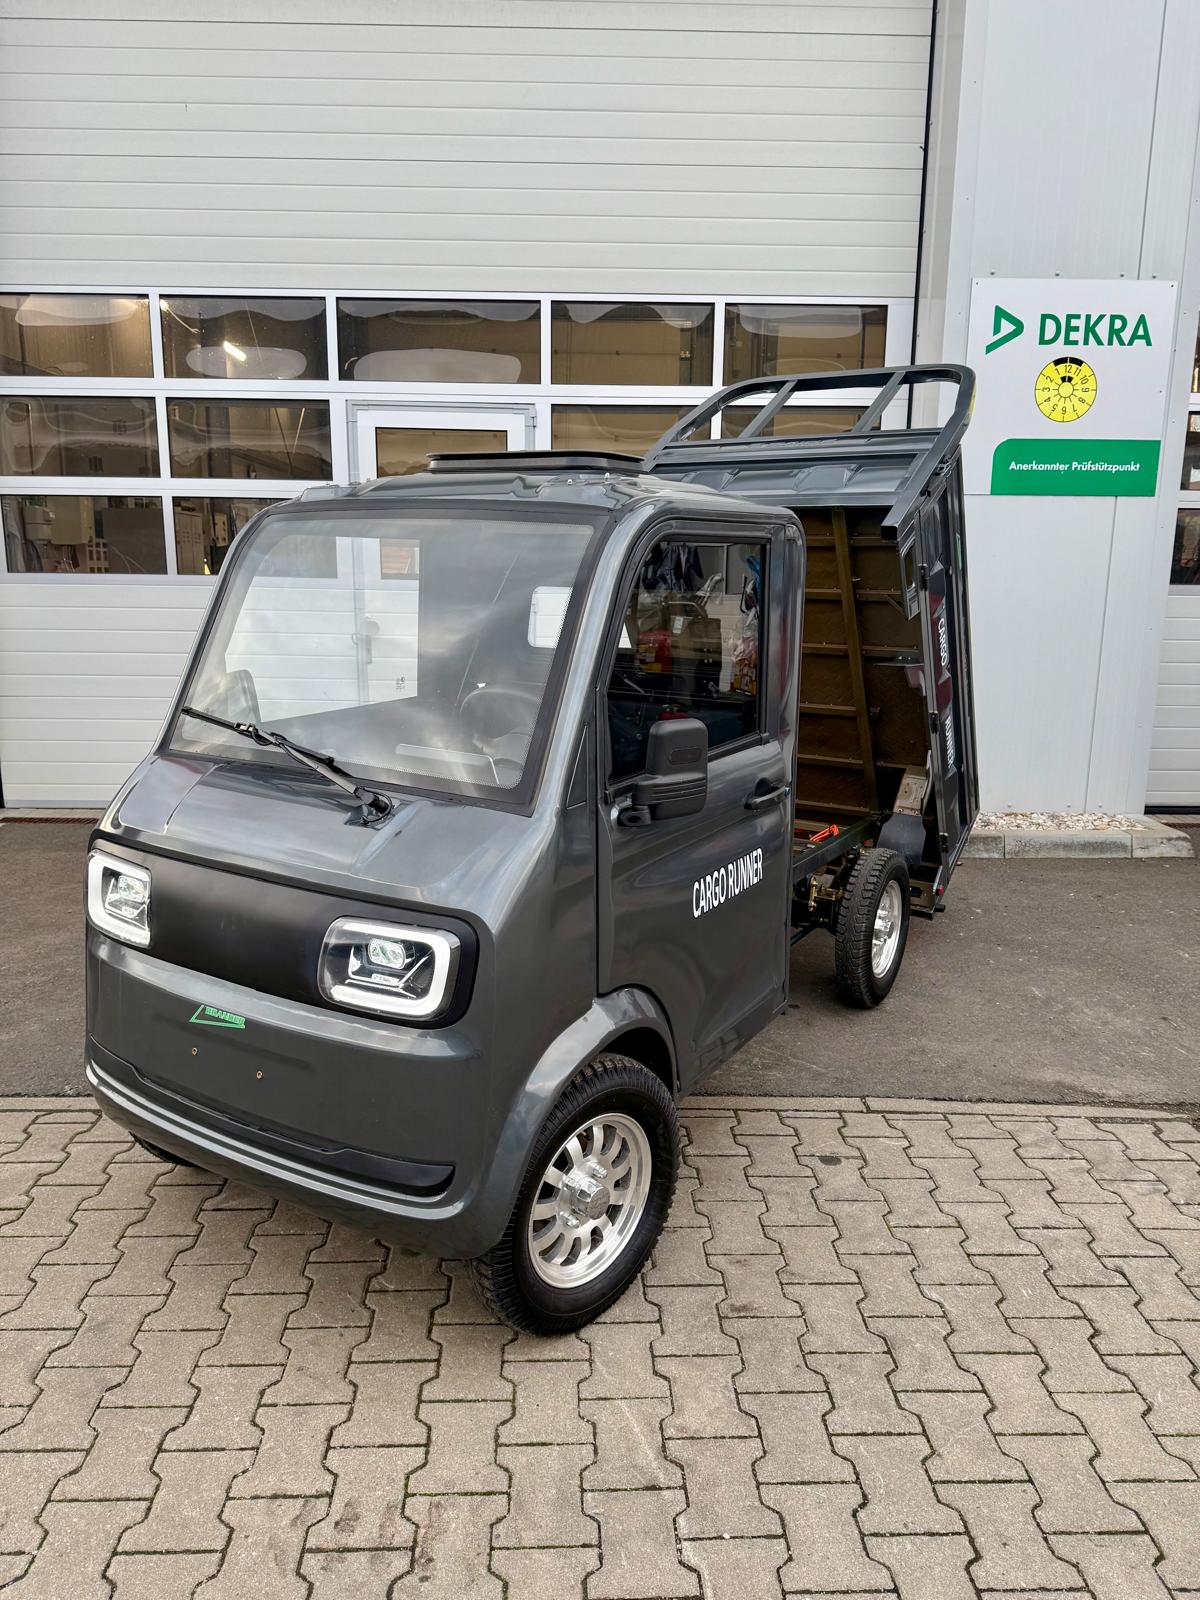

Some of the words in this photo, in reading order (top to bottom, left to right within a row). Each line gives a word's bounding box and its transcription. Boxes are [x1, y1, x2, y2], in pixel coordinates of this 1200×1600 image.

[1038, 313, 1153, 347] DEKRA
[1064, 364, 1072, 374] 12
[1073, 367, 1082, 377] 11
[1079, 375, 1089, 385] 10
[1008, 461, 1069, 471] Anerkannter
[1071, 461, 1141, 473] Prüfstützpunkt
[938, 618, 947, 666] CARGO
[692, 867, 727, 919] CARGO
[728, 847, 763, 899] RUNNER
